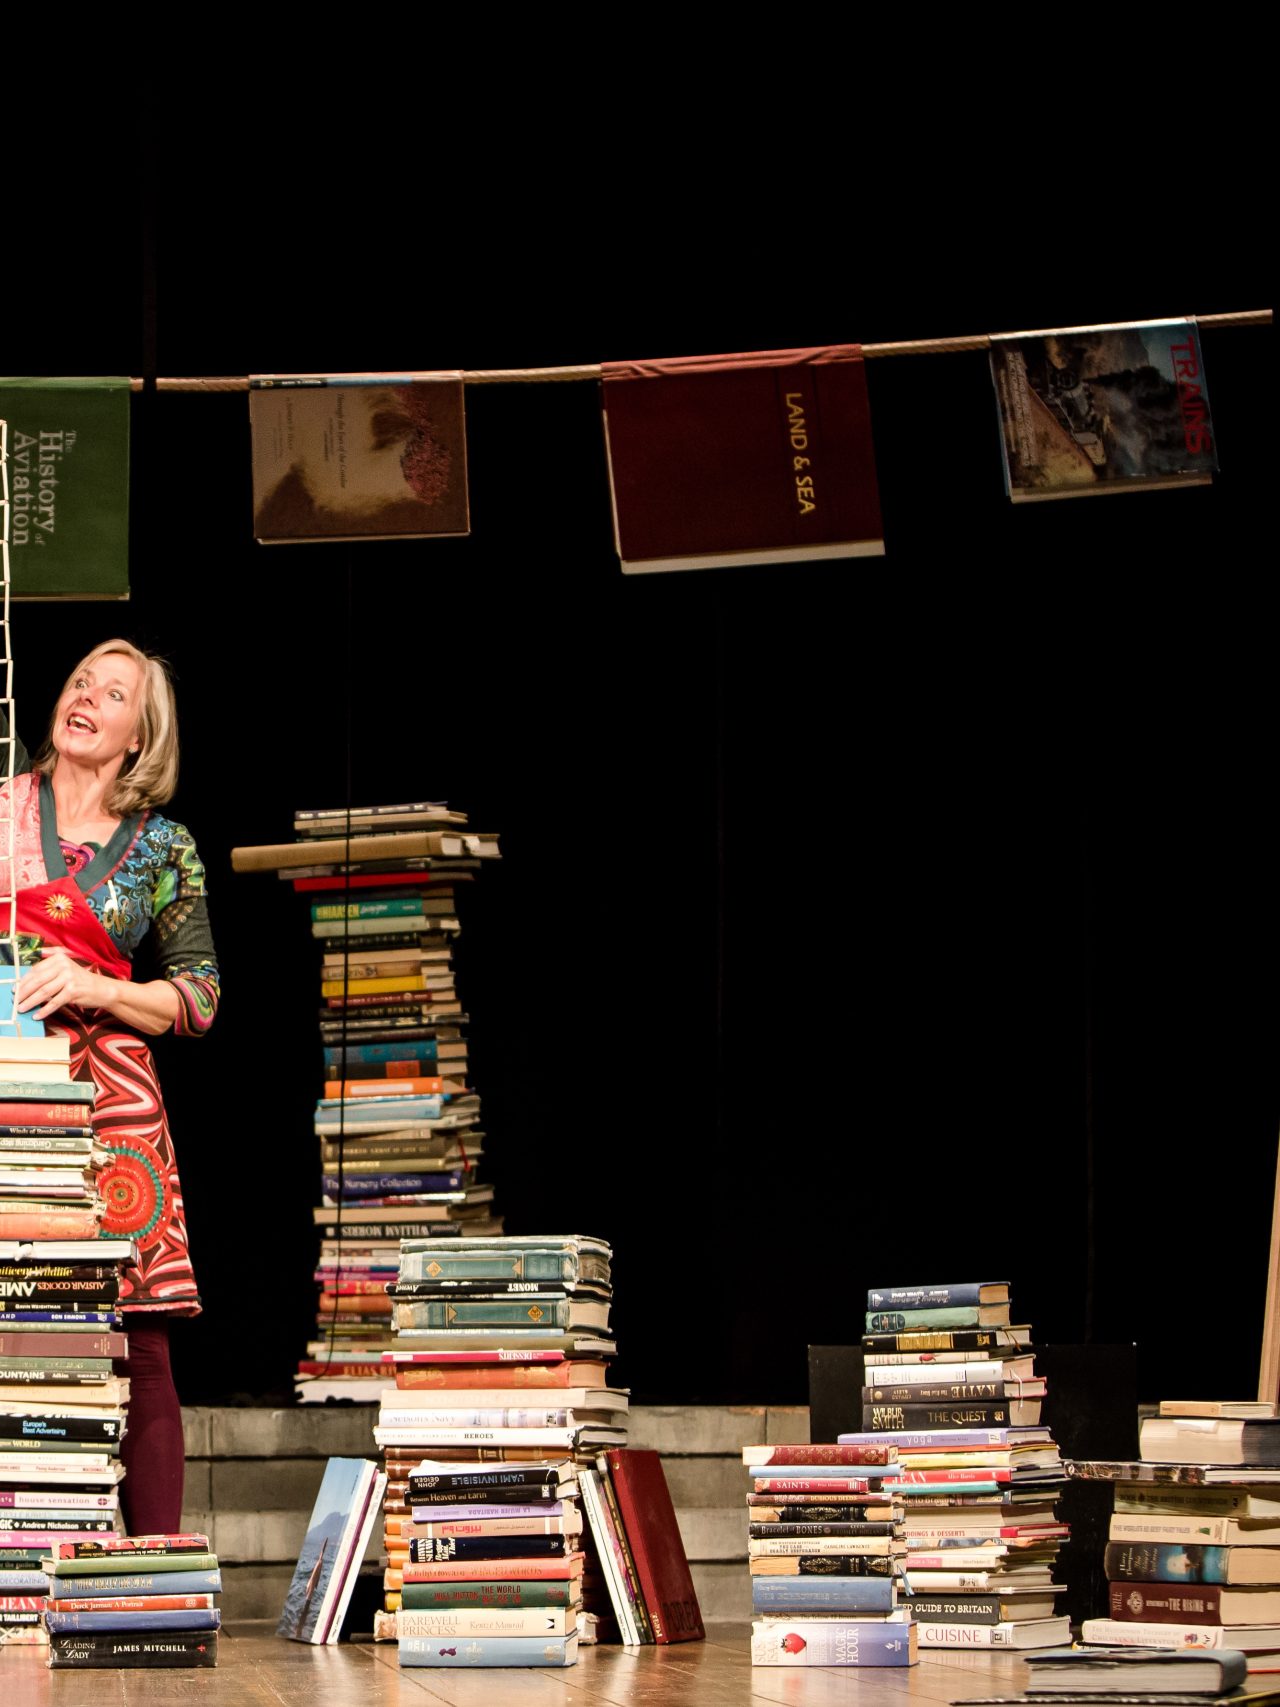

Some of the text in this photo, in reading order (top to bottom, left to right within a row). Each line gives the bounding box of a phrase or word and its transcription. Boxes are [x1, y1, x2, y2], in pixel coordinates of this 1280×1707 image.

[1171, 335, 1213, 454] TRAINS
[785, 392, 816, 515] LAND & SEA
[33, 430, 63, 533] History
[12, 430, 38, 546] Aviation
[344, 1177, 422, 1190] Nursery Collection
[72, 1282, 106, 1290] ALISTAIR
[507, 1283, 539, 1292] MONET
[951, 1384, 996, 1398] KATIE
[872, 1407, 987, 1424] WILBUR THE QUEST
[22, 1421, 46, 1429] Europe's
[872, 1415, 905, 1429] SMITH
[36, 1428, 66, 1436] Advertising
[906, 1435, 932, 1445] yoga
[451, 1475, 497, 1486] INVISIBLE
[497, 1474, 525, 1485] L'AMI
[776, 1481, 810, 1489] SAINTS
[430, 1492, 457, 1502] Heaven
[22, 1521, 45, 1529] Andrew
[47, 1522, 79, 1530] Nicholson
[761, 1525, 822, 1534] Bracelet BONES
[0, 1597, 37, 1610] JEAN
[915, 1604, 993, 1614] GUIDE TO BRITAIN
[402, 1616, 461, 1626] FAREWELL
[402, 1626, 456, 1635] PRINCESS
[926, 1628, 982, 1643] CUISINE
[59, 1639, 187, 1653] LEADING JAMES MITCHELL
[836, 1627, 846, 1664] MAGIC
[847, 1628, 859, 1664] HOUR
[65, 1648, 90, 1659] LADY
